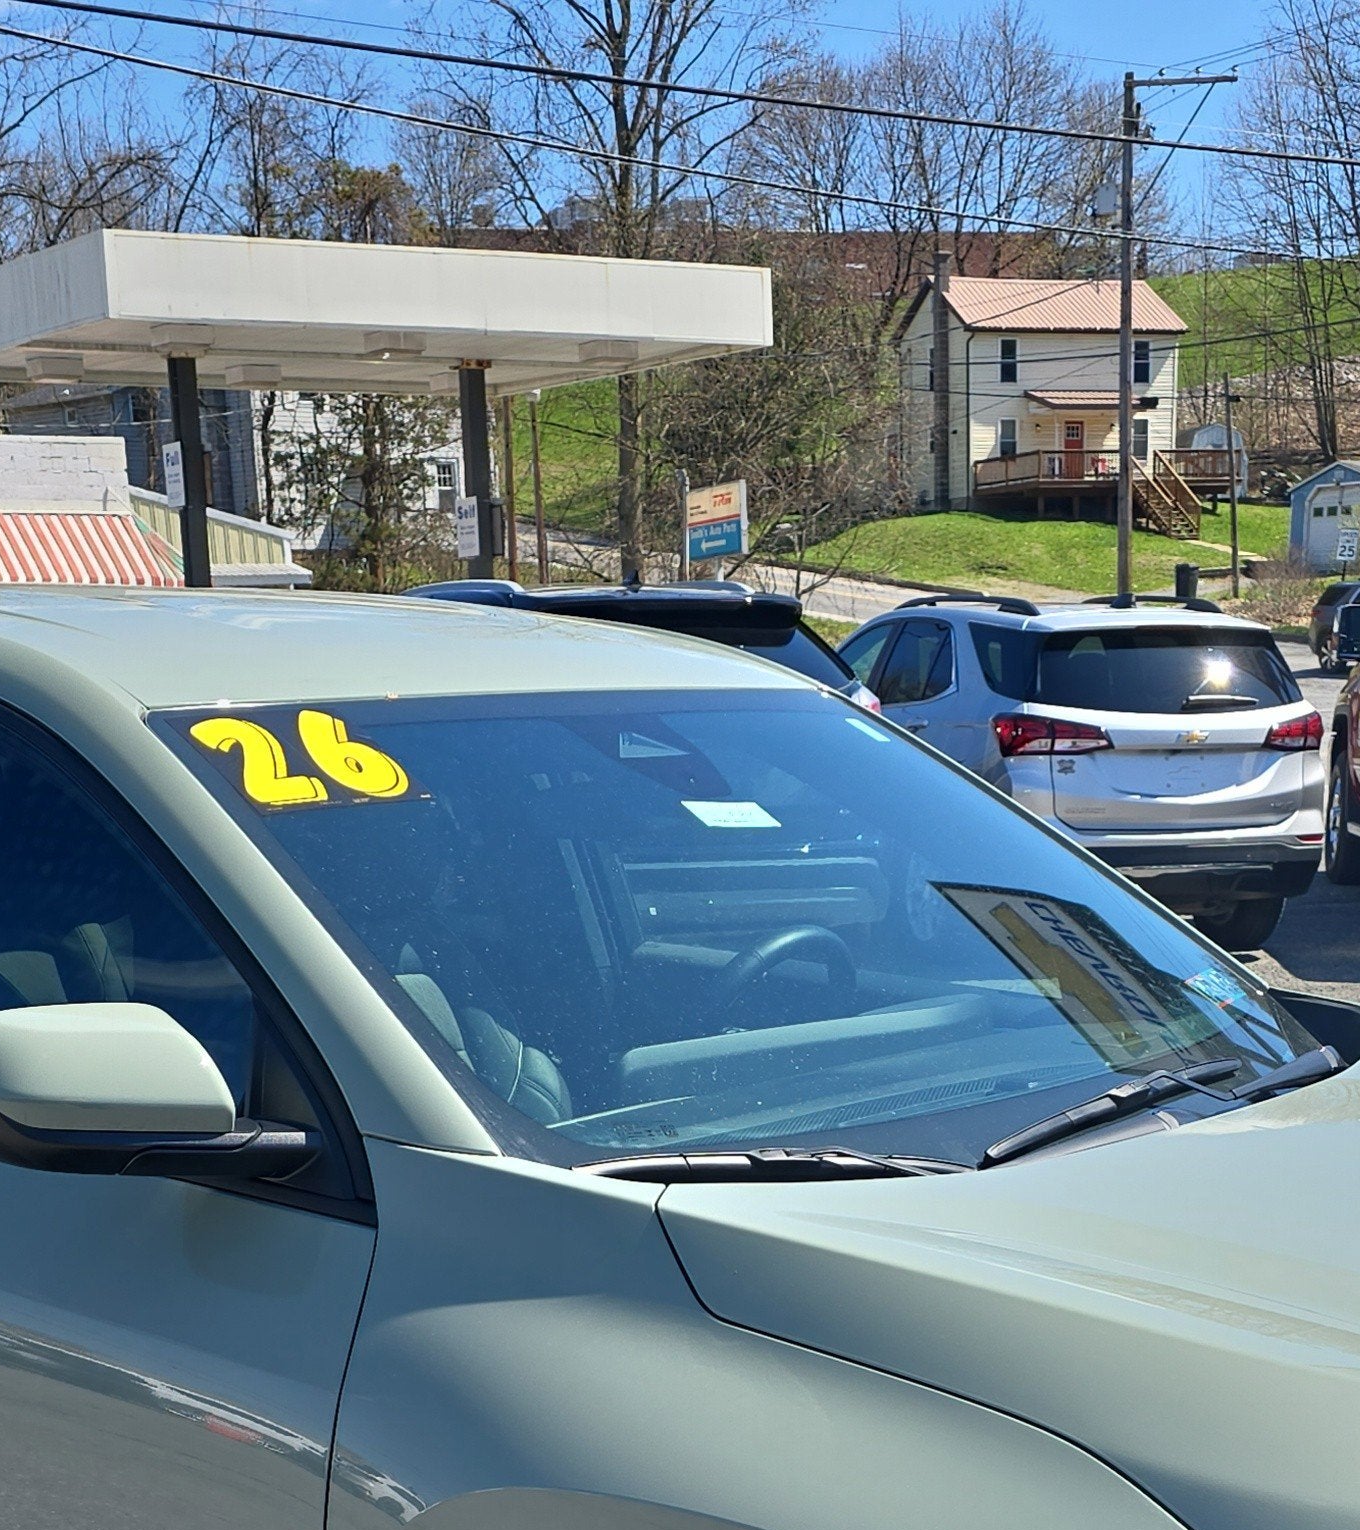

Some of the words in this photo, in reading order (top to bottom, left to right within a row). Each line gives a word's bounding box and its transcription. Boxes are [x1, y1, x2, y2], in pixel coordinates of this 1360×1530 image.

[457, 504, 475, 520] Self
[1339, 545, 1355, 557] 25
[190, 709, 410, 806] 26
